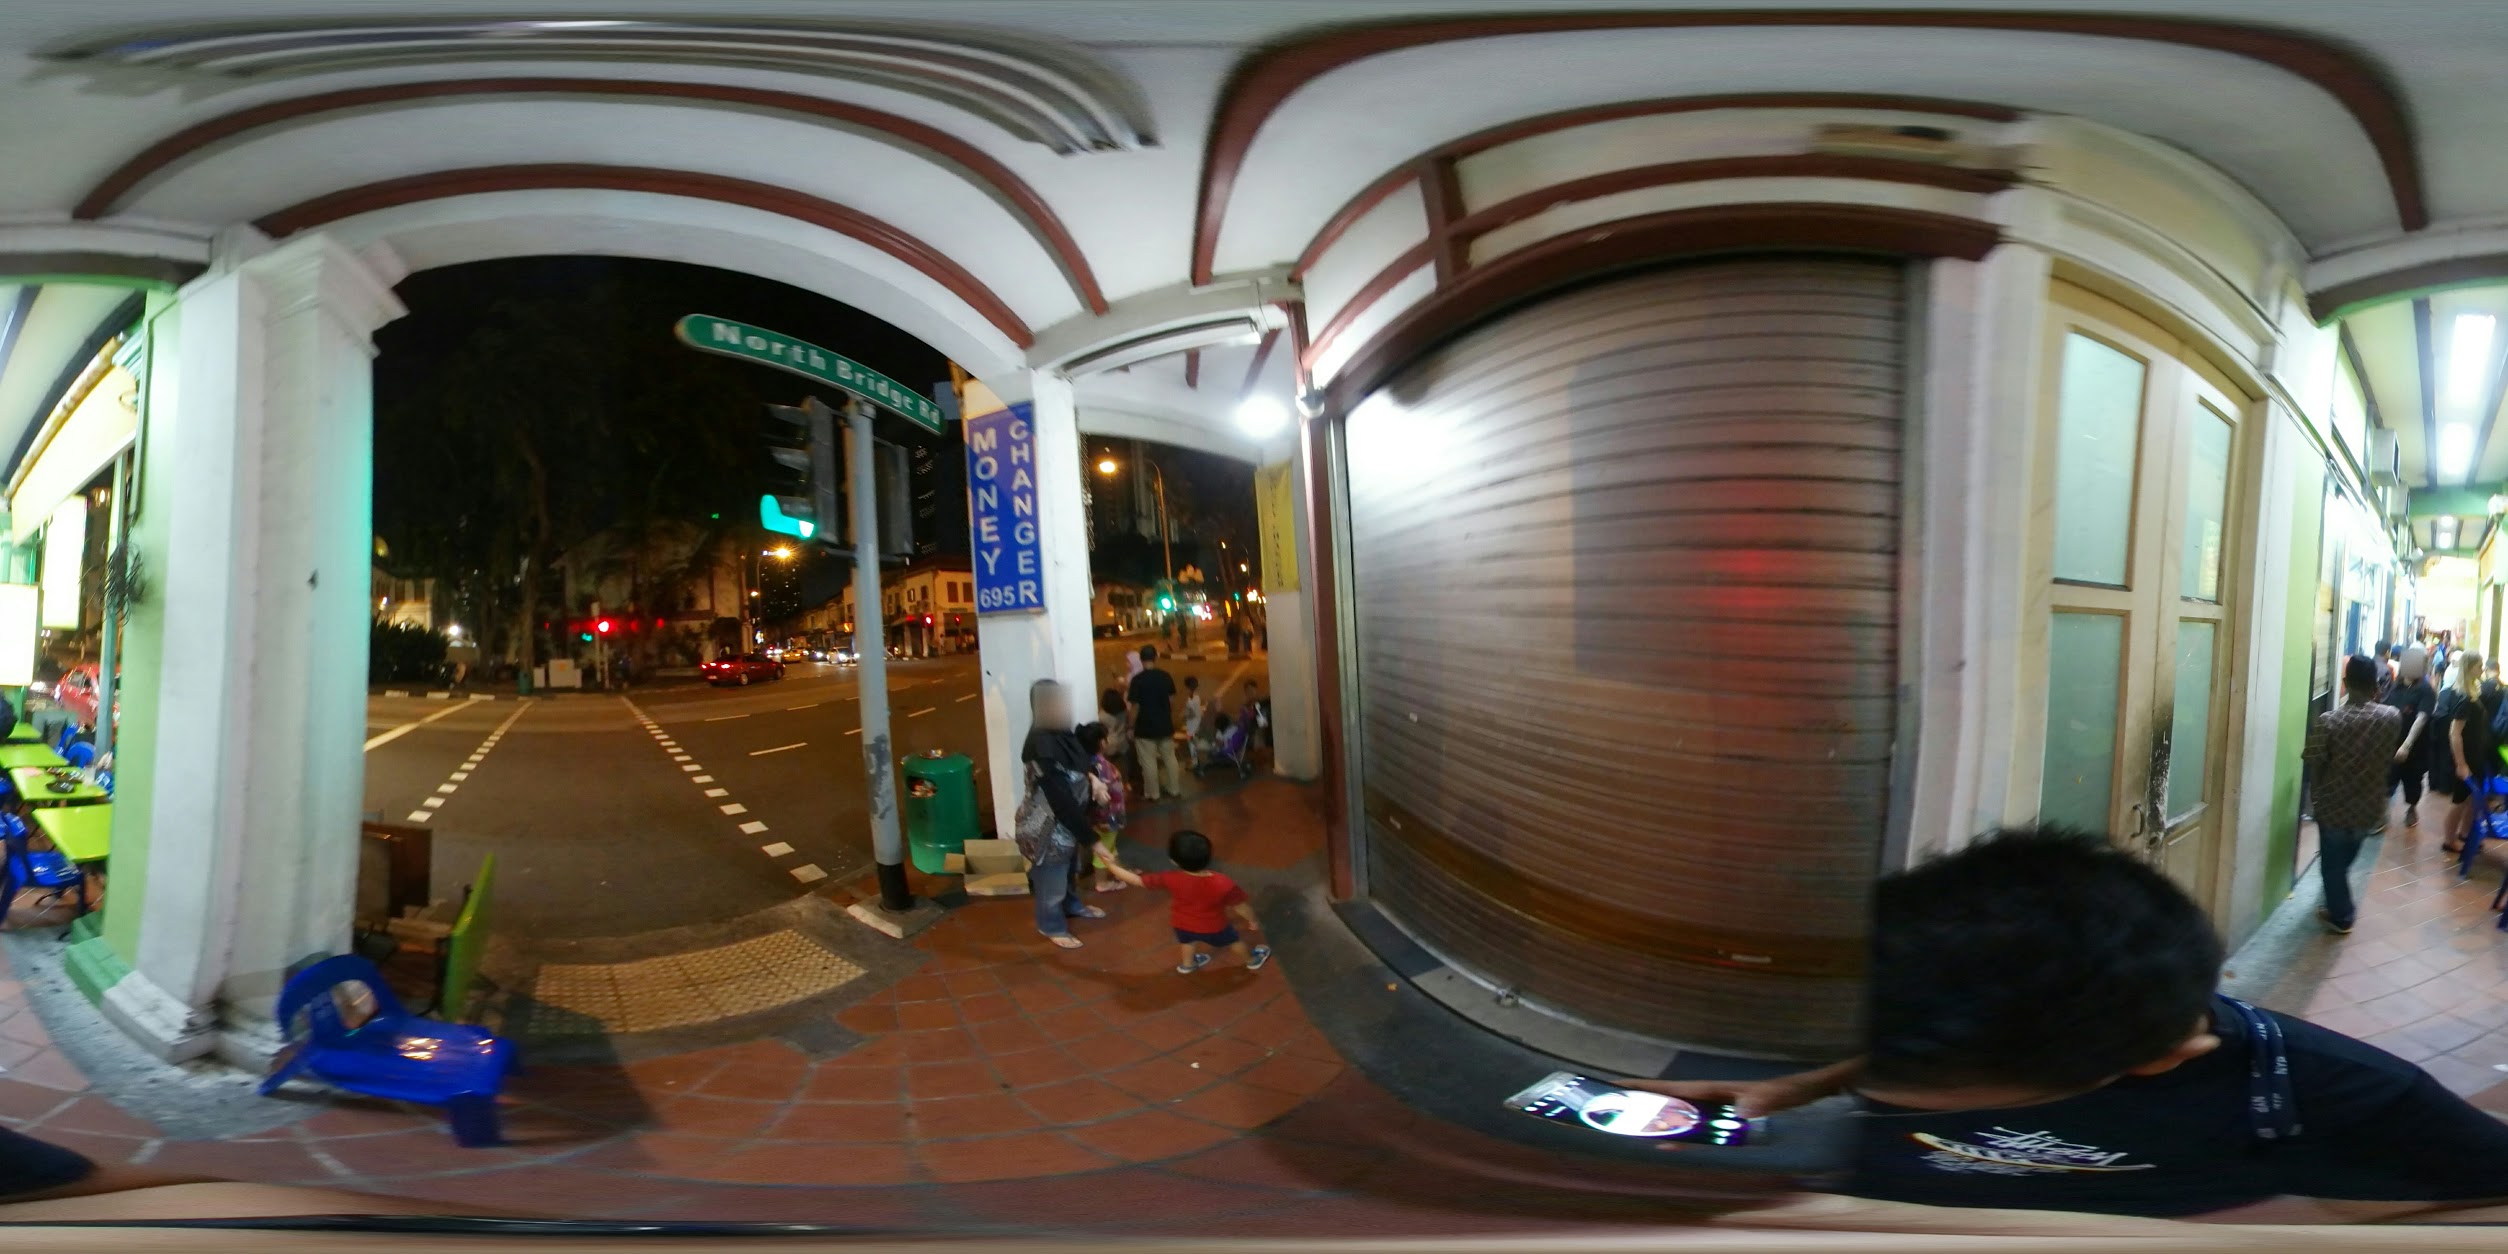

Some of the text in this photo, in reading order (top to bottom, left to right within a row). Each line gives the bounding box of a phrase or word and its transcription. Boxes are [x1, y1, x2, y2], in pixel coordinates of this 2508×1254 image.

[712, 322, 940, 426] North Bridge Rd
[973, 427, 1001, 576] MONEY
[1008, 420, 1039, 605] CHANGER
[980, 585, 1016, 609] 695
